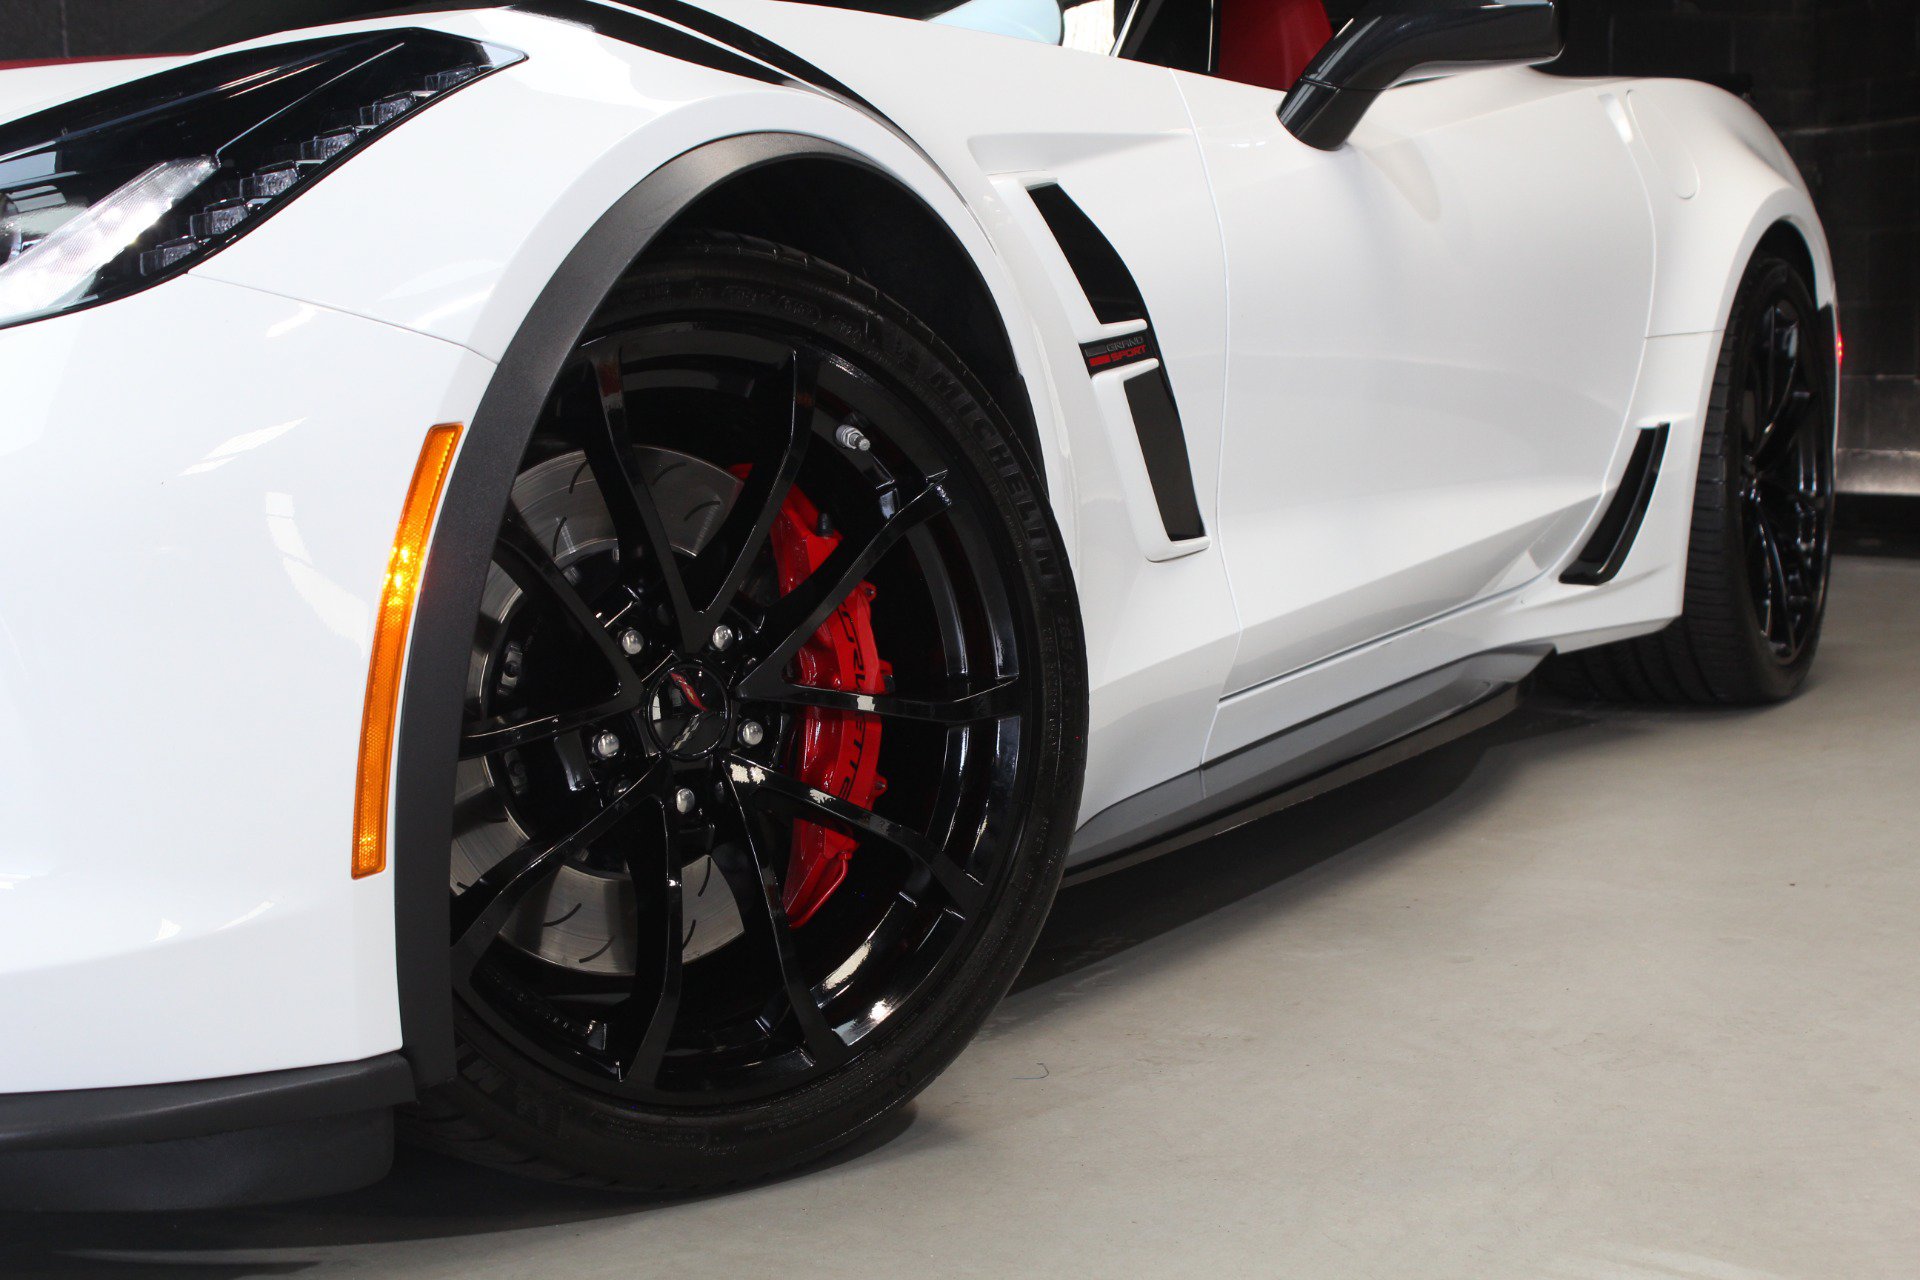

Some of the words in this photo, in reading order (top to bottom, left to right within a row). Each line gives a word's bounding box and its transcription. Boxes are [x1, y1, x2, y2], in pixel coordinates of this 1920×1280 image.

[1106, 336, 1143, 352] GRAND
[1110, 345, 1147, 362] SPORT
[928, 366, 1063, 578] MICHELIN
